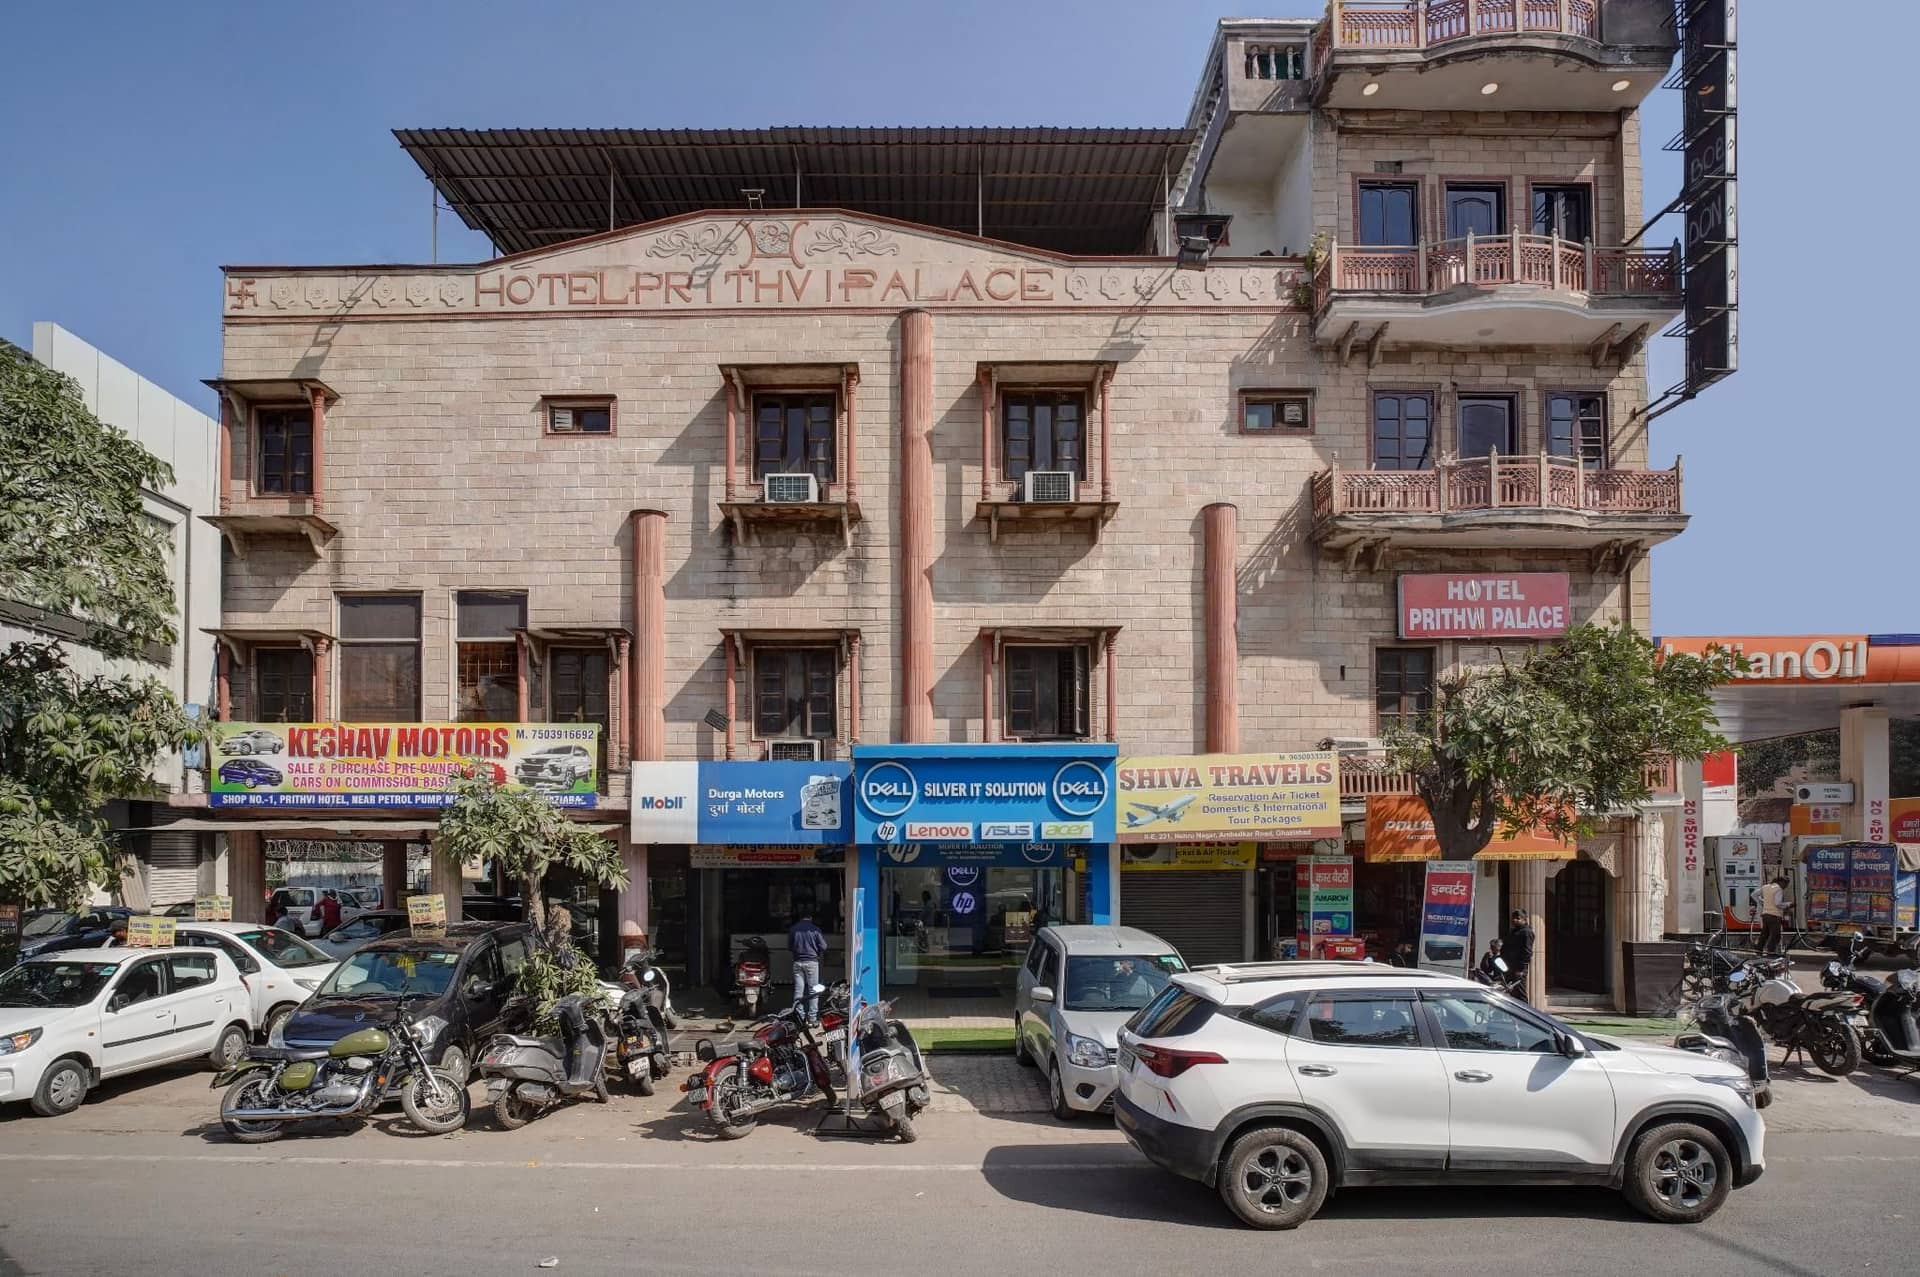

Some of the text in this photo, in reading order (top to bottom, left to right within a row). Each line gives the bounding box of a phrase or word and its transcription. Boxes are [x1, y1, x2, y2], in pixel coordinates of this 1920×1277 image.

[475, 268, 1054, 307] HOTEL PRITHVI PALACE
[1447, 579, 1526, 602] HOTEL
[1409, 606, 1564, 631] PRITHVI PALACE
[516, 729, 528, 740] M.
[288, 726, 510, 760] KESHAV MOTORS
[288, 763, 315, 774] SALE
[319, 763, 326, 774] &
[331, 762, 390, 775] PURCHASE
[293, 776, 449, 788] CARS ON COMMISSION BASI
[1119, 762, 1334, 791] SHIVA TRAVELS
[708, 789, 785, 800] Durga Motors
[868, 782, 912, 797] DELL
[925, 782, 1047, 797] SILVER IT SOLUTION
[1060, 781, 1104, 796] DELL
[222, 794, 247, 805] SHOP
[280, 794, 315, 804] PRITHVI
[318, 794, 350, 806] HOTEL,
[351, 794, 376, 805] NEAR
[378, 794, 414, 804] PETROL
[416, 794, 443, 806] PUMP,
[642, 797, 684, 809] Mobil
[1208, 791, 1320, 803] Reservation Air Ticket
[708, 800, 766, 818] दुर्गा मोटर्स
[1202, 802, 1328, 814] Domestic & International
[1870, 800, 1883, 815] NO
[1228, 814, 1302, 825] Tour Packages
[880, 822, 895, 841] hp
[909, 824, 969, 837] Lenovo
[984, 825, 1031, 836] ASUS
[1045, 824, 1090, 836] acer
[1684, 800, 1698, 871] NO SMOKING
[951, 867, 975, 876] DELL
[955, 892, 974, 914] hp
[1314, 894, 1349, 902] AMARON
